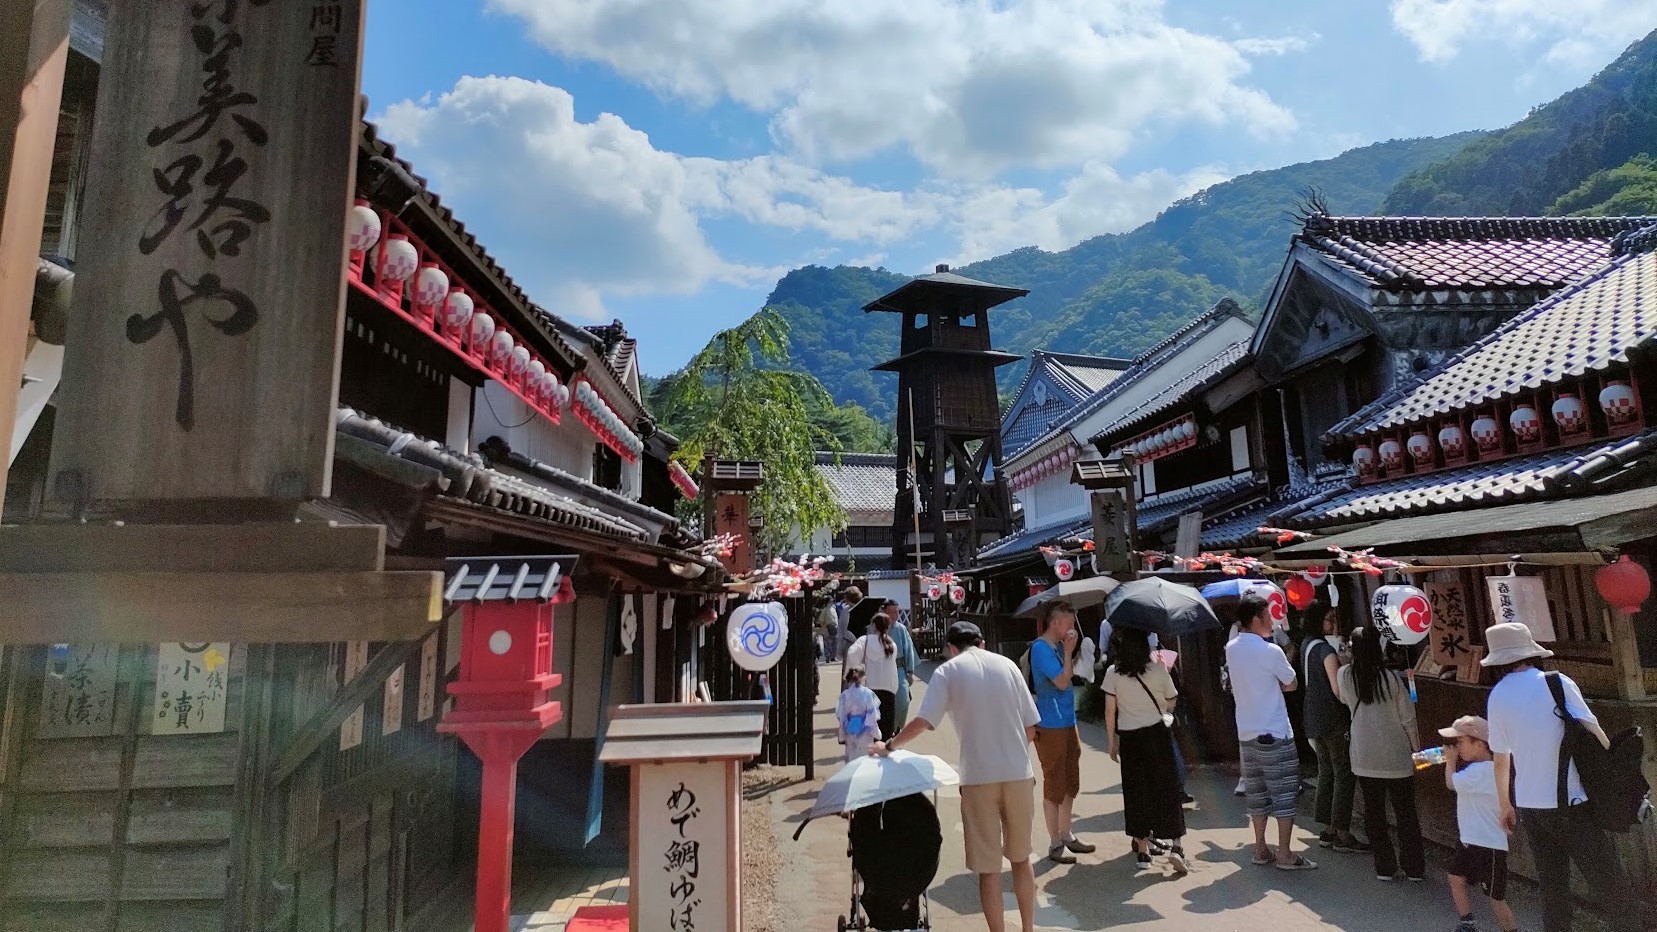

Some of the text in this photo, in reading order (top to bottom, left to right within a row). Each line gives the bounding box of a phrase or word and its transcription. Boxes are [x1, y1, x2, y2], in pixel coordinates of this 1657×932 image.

[303, 4, 342, 67] 問屋
[174, 659, 201, 729] 小賣
[663, 782, 701, 931] めで鯛ゆば
